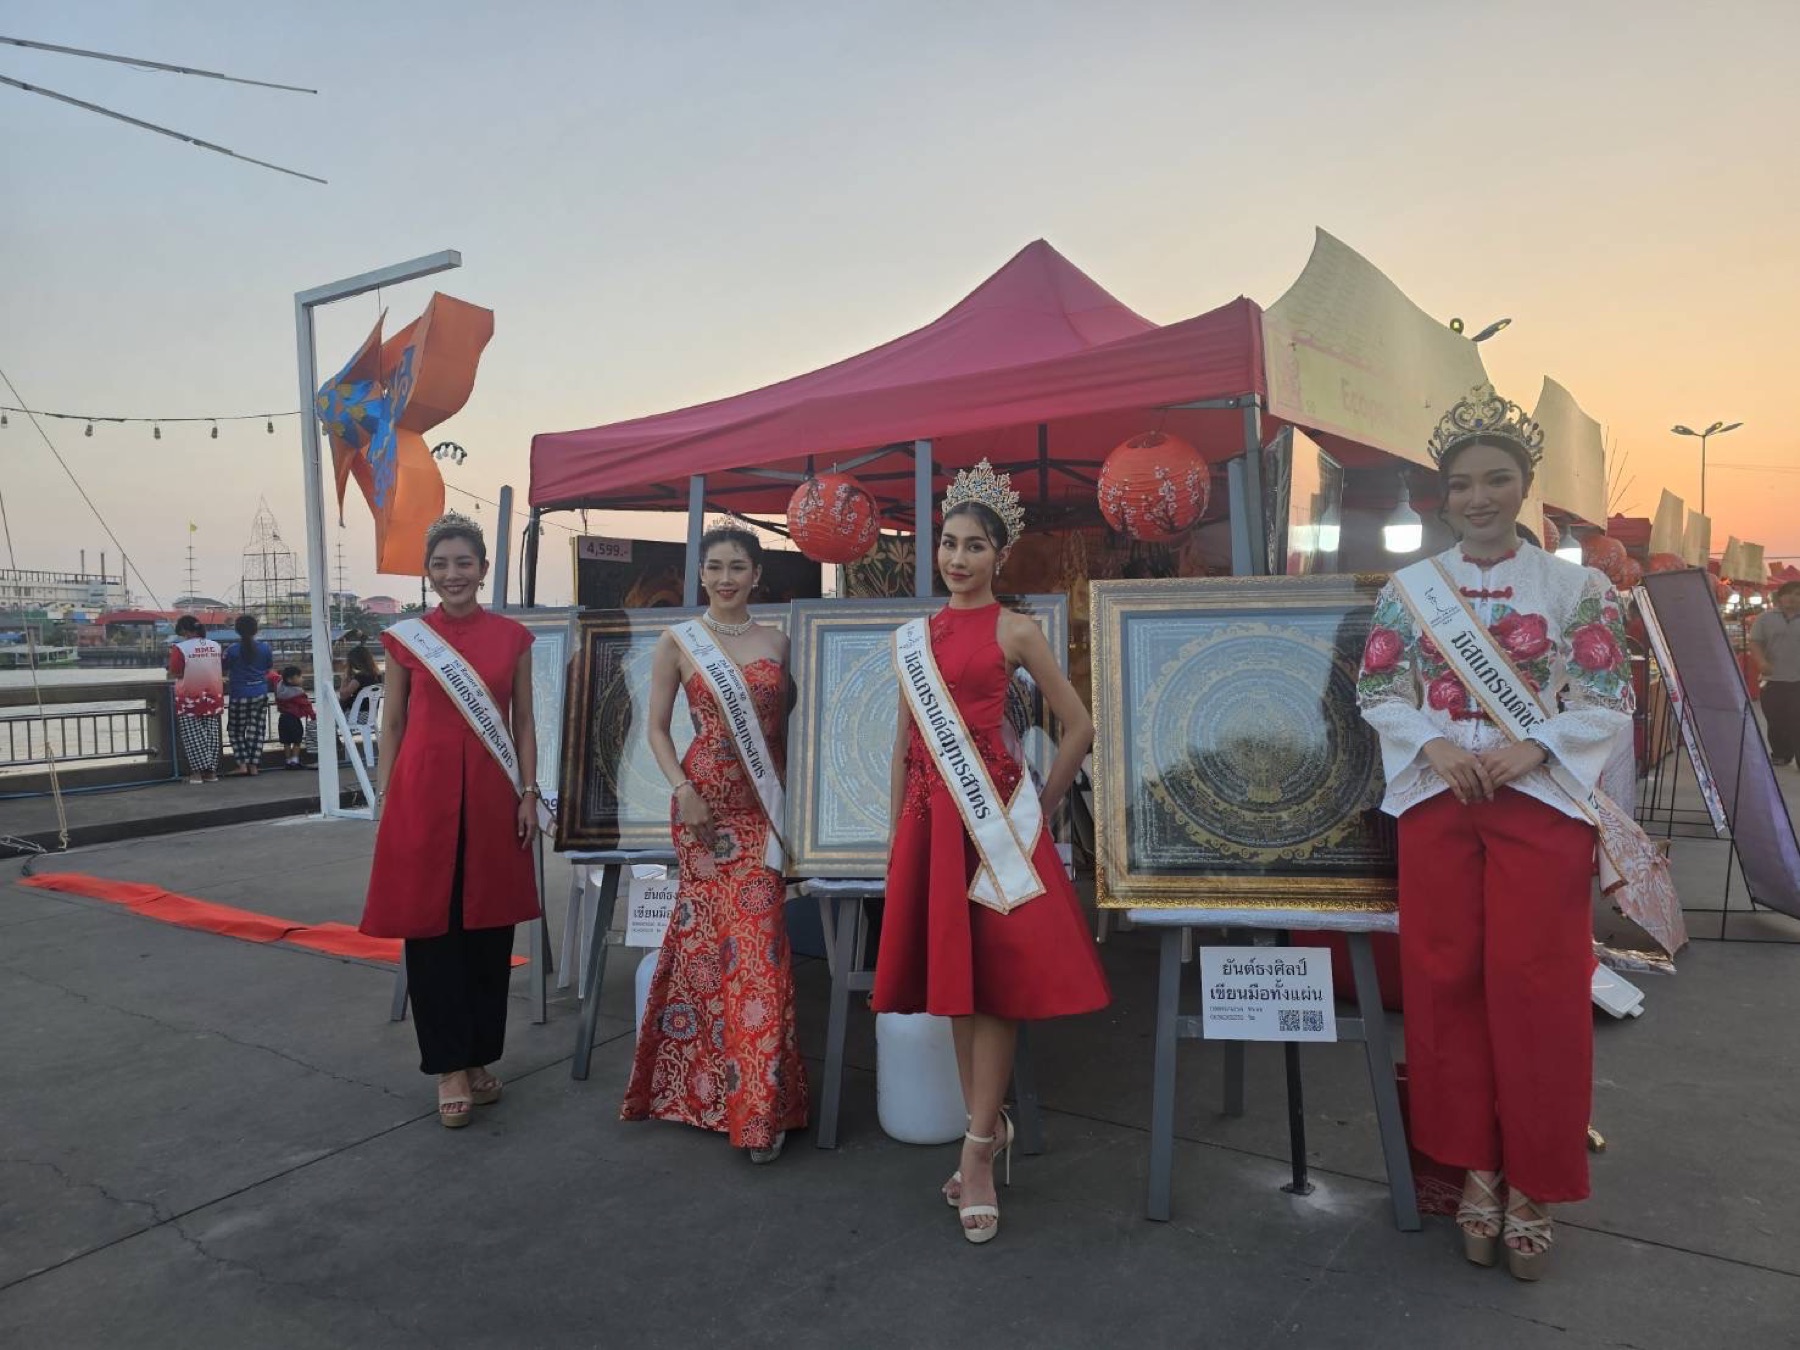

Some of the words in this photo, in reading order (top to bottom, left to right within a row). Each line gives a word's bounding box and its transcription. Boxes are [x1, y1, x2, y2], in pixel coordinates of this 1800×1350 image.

[586, 542, 629, 557] 4,599.-
[440, 663, 515, 769] มิสแกรนด์สมุทรสาคร
[706, 662, 767, 780] มิสแกรนด์สมุทรสาคร
[903, 649, 991, 821] มิสแกรนด์สมุทรสาคร
[1210, 979, 1323, 1002] เขียนมือทั้งแผ่น
[1222, 957, 1308, 976] ยันต์ธงศิลป์
